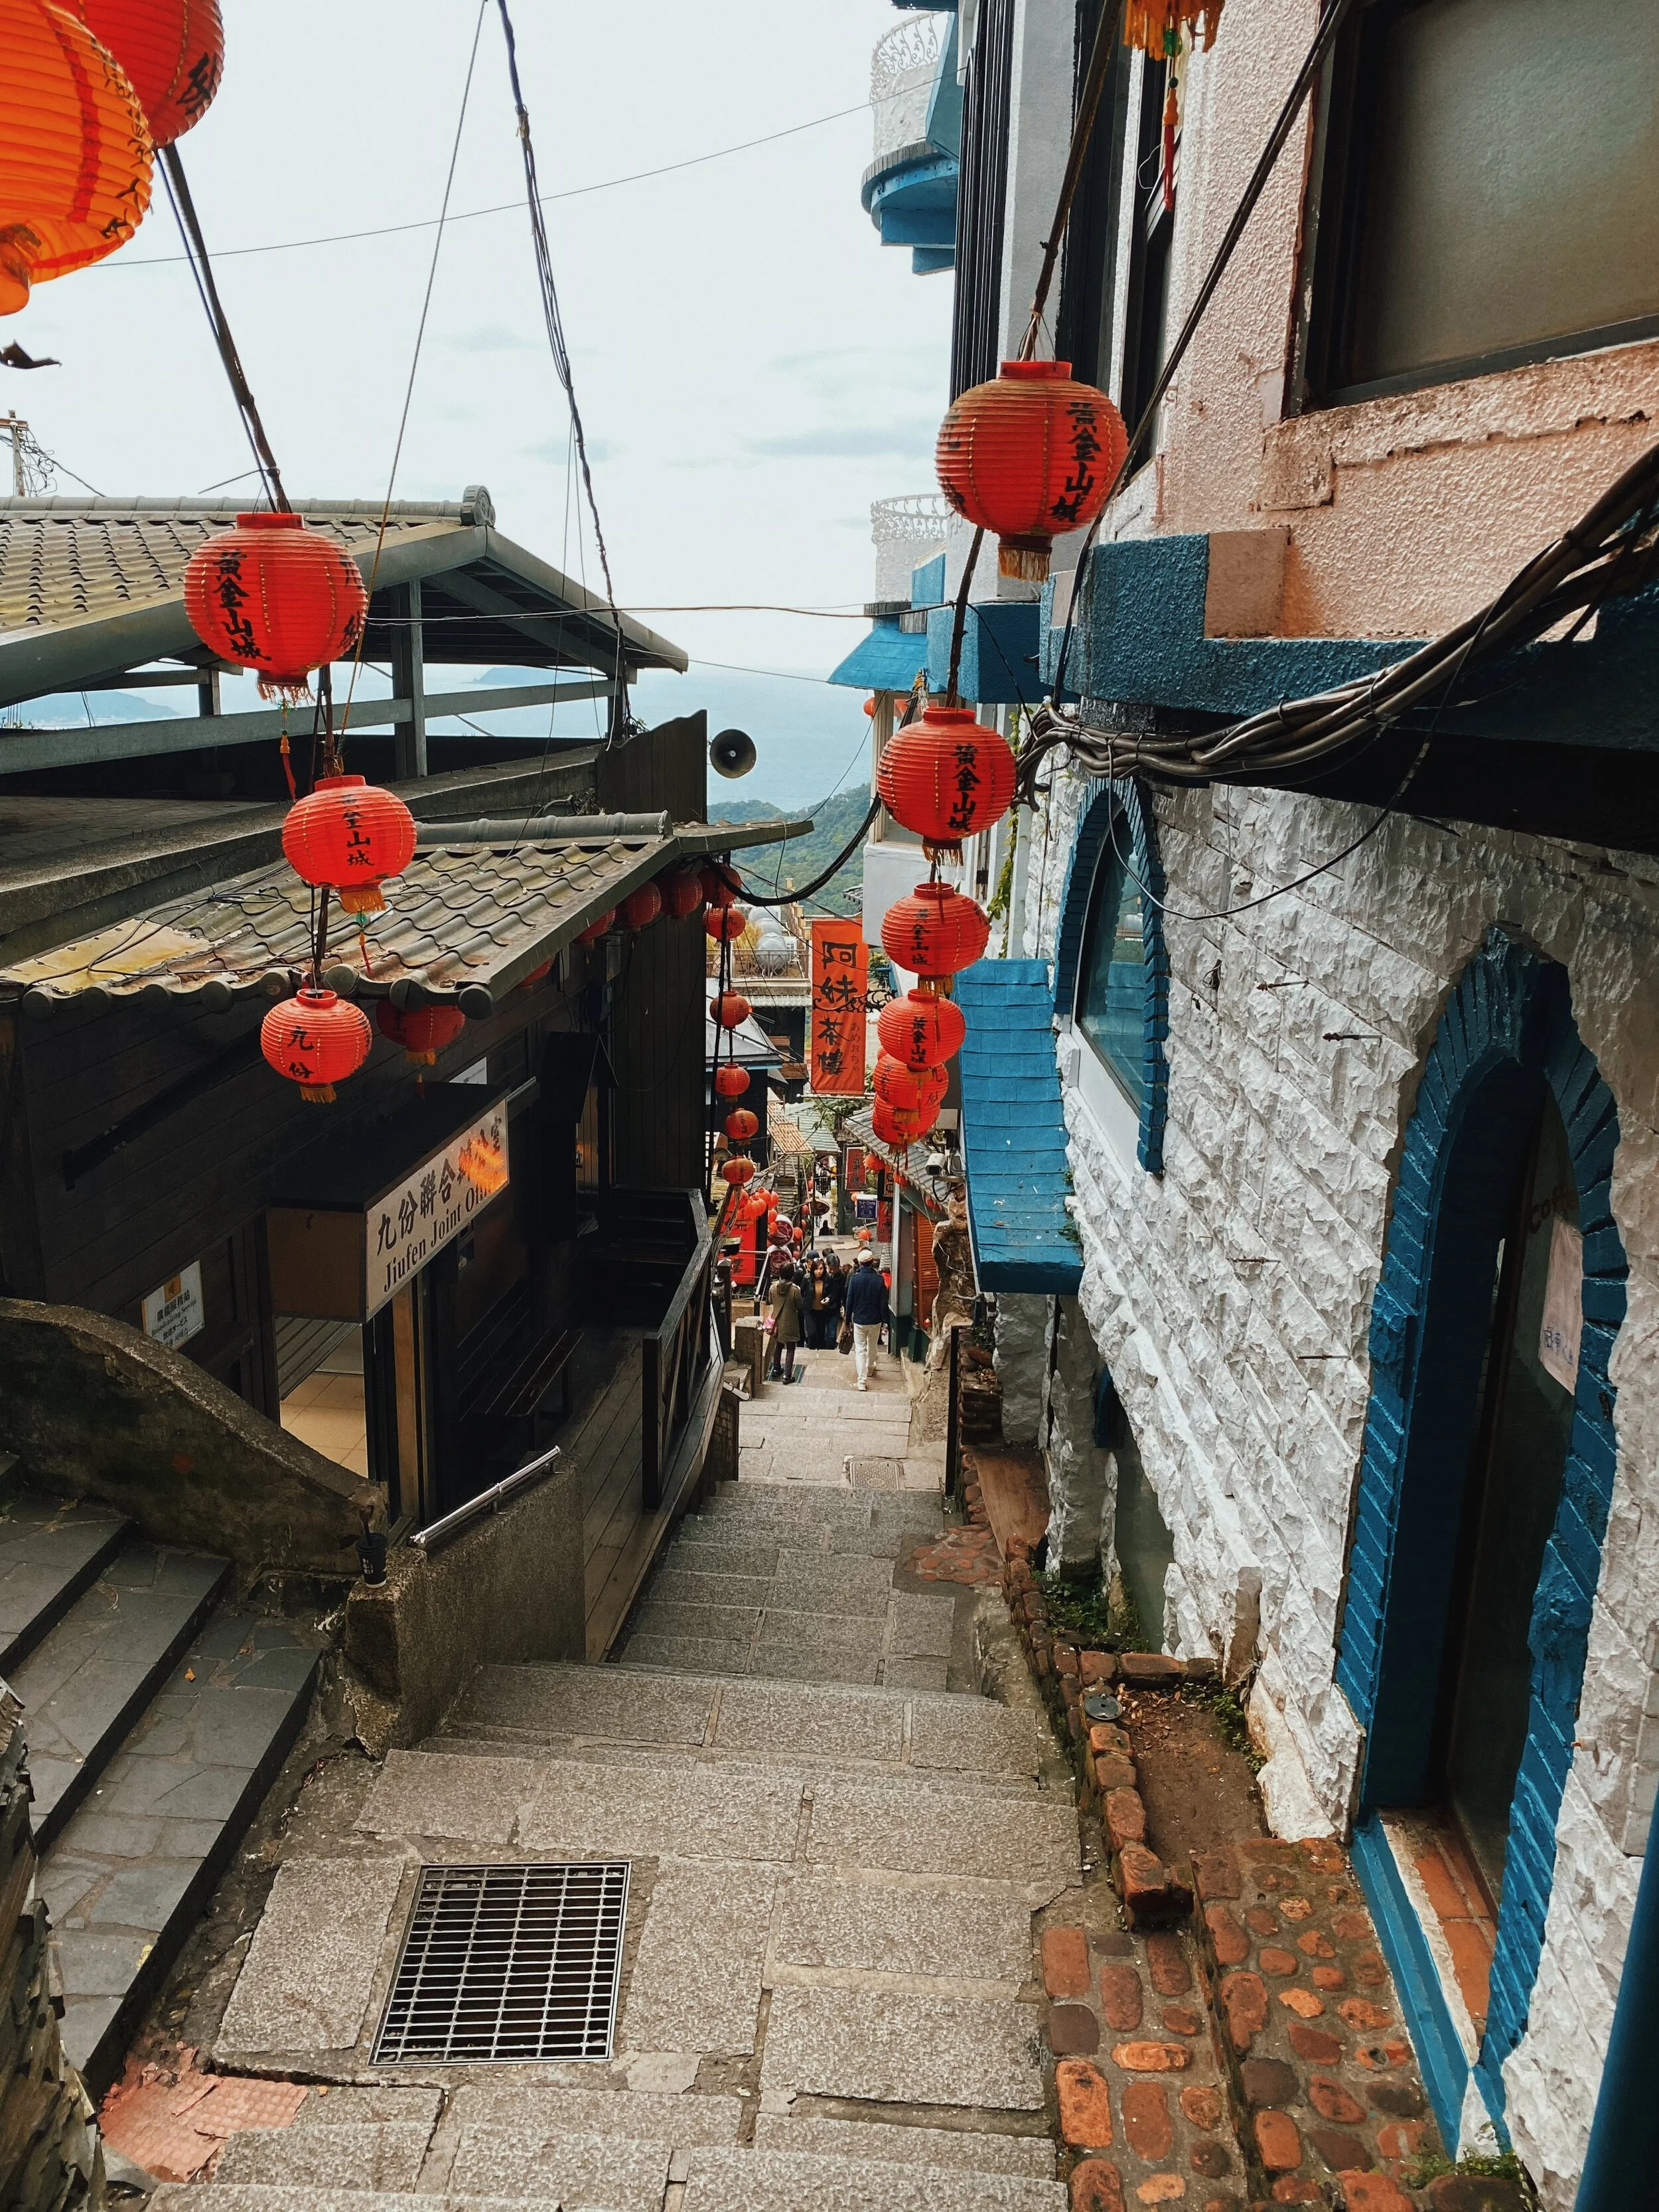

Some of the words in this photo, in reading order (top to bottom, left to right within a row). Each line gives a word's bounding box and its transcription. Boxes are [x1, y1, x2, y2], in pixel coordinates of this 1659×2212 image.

[1048, 401, 1102, 523] 黃金山城
[212, 549, 273, 661] 黃金山城
[340, 794, 375, 867] 黃金山城
[945, 743, 981, 831] 黃金山城
[910, 909, 932, 966] 黃金山城
[817, 940, 858, 1075] 阿妹茶樓
[911, 1017, 928, 1064] 黃金山城
[287, 1025, 315, 1079] 九份
[384, 1238, 427, 1293] Jiufen
[431, 1204, 461, 1248] Joint
